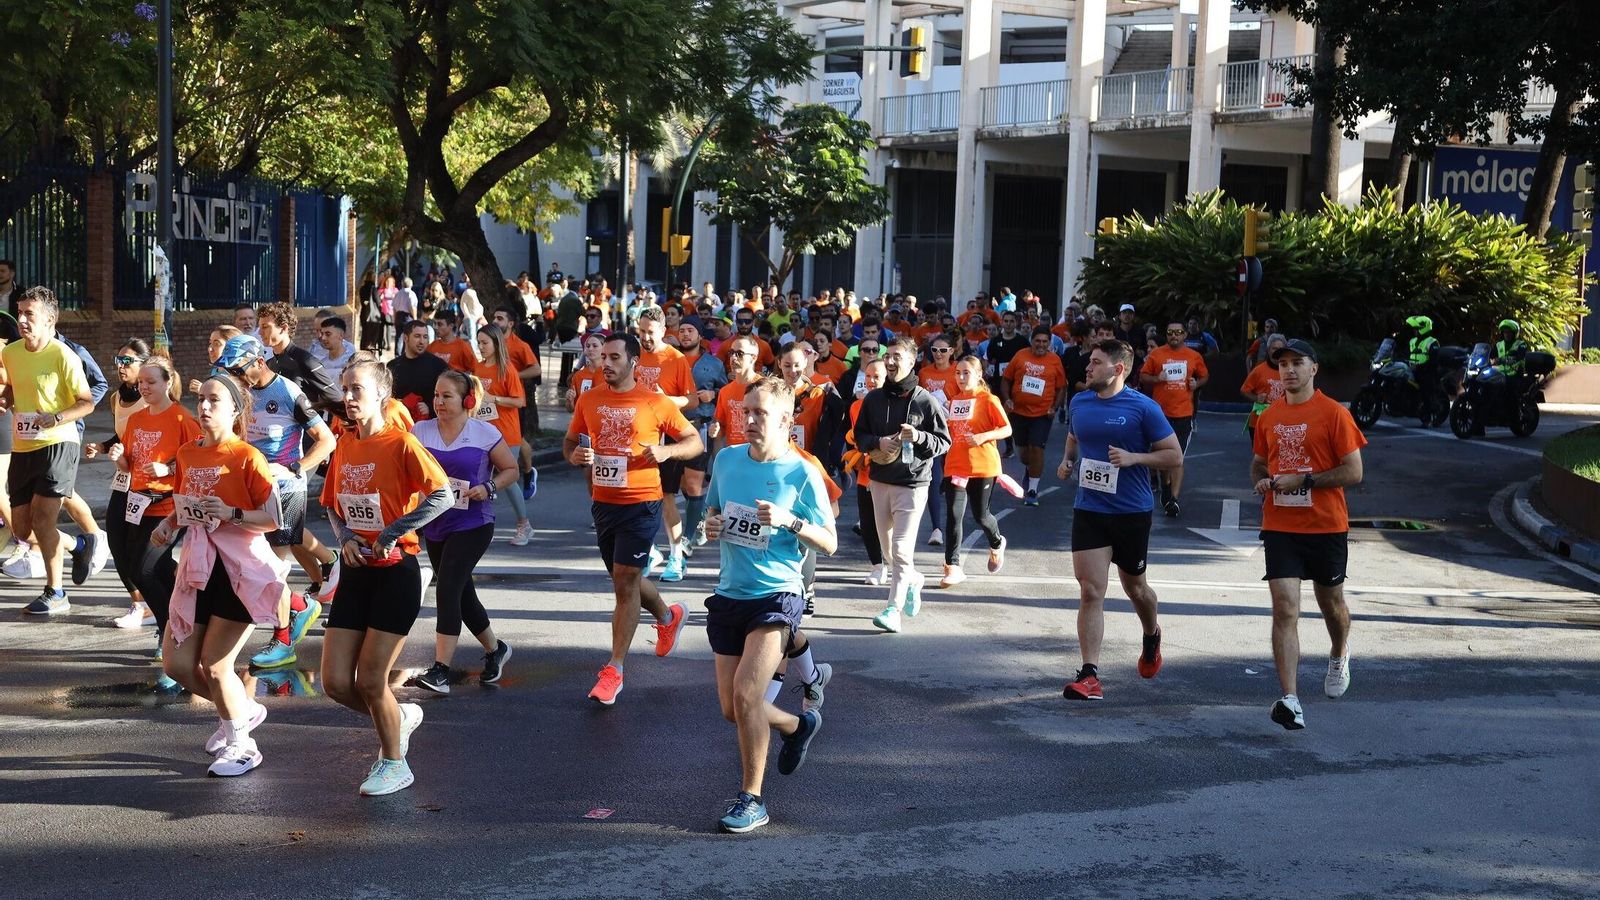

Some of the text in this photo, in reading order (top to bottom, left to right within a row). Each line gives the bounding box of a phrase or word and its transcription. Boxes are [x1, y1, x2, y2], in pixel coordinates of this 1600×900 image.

[17, 421, 40, 432] 874
[595, 465, 619, 478] 207
[1085, 469, 1110, 484] 361
[347, 506, 375, 520] 856
[728, 516, 761, 536] 798
